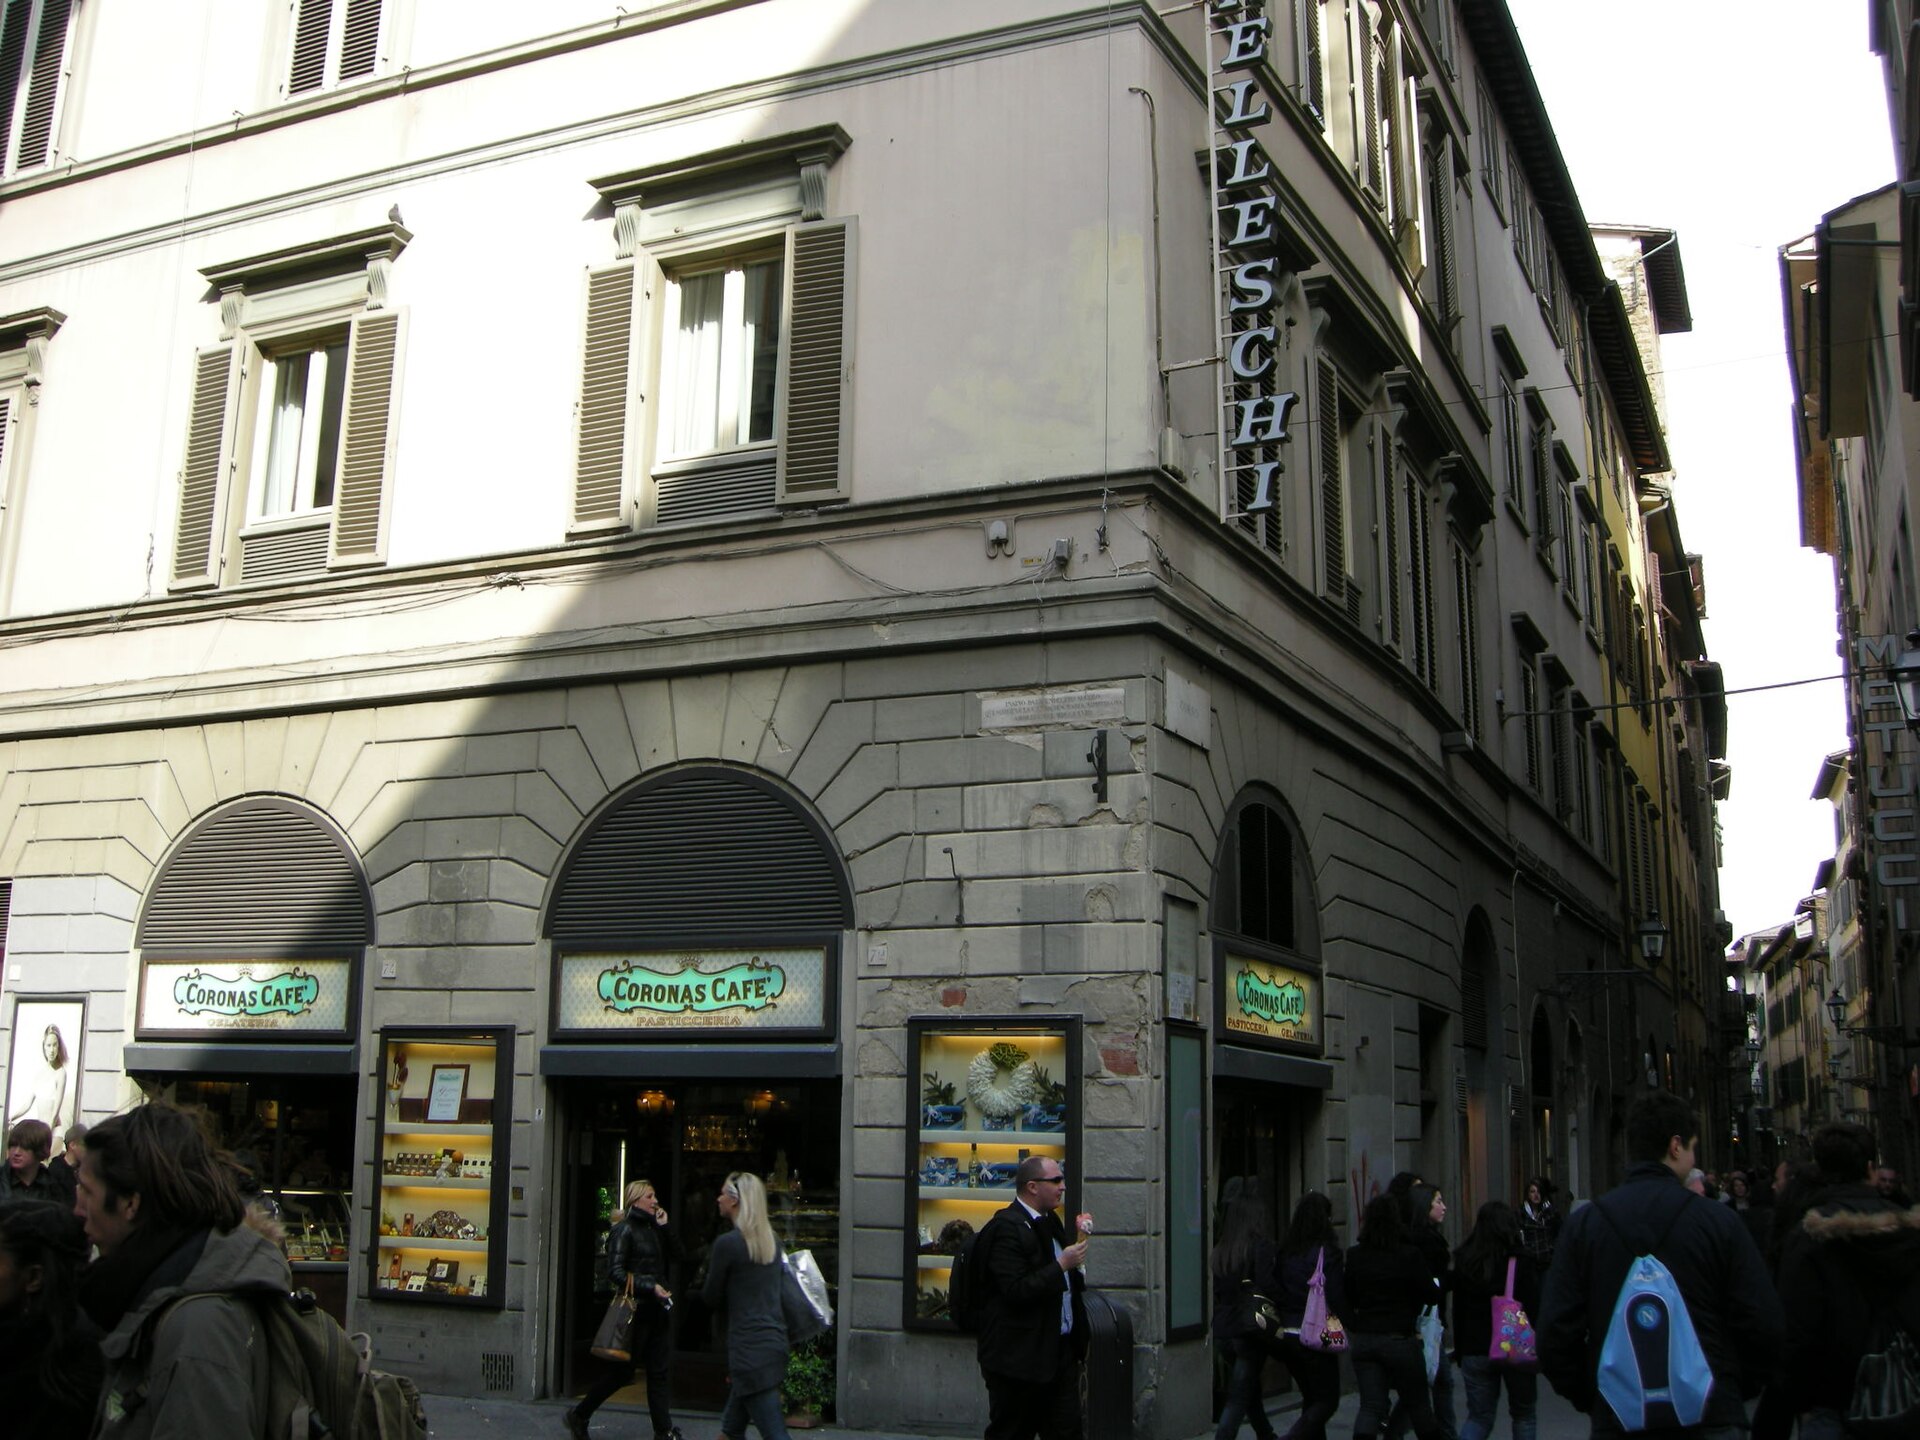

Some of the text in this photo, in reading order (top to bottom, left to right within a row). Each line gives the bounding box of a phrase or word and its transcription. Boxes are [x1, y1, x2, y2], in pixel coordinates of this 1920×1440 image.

[1219, 0, 1299, 513] ELLESCHI
[186, 983, 257, 1007] CORONAS
[614, 977, 706, 1004] CORONAS
[1243, 980, 1279, 1014] CORONAS
[207, 1018, 278, 1027] GELATERIA
[636, 1015, 742, 1027] PASTICCERIA
[1227, 1017, 1313, 1041] PASTICCERIA GELATERIA
